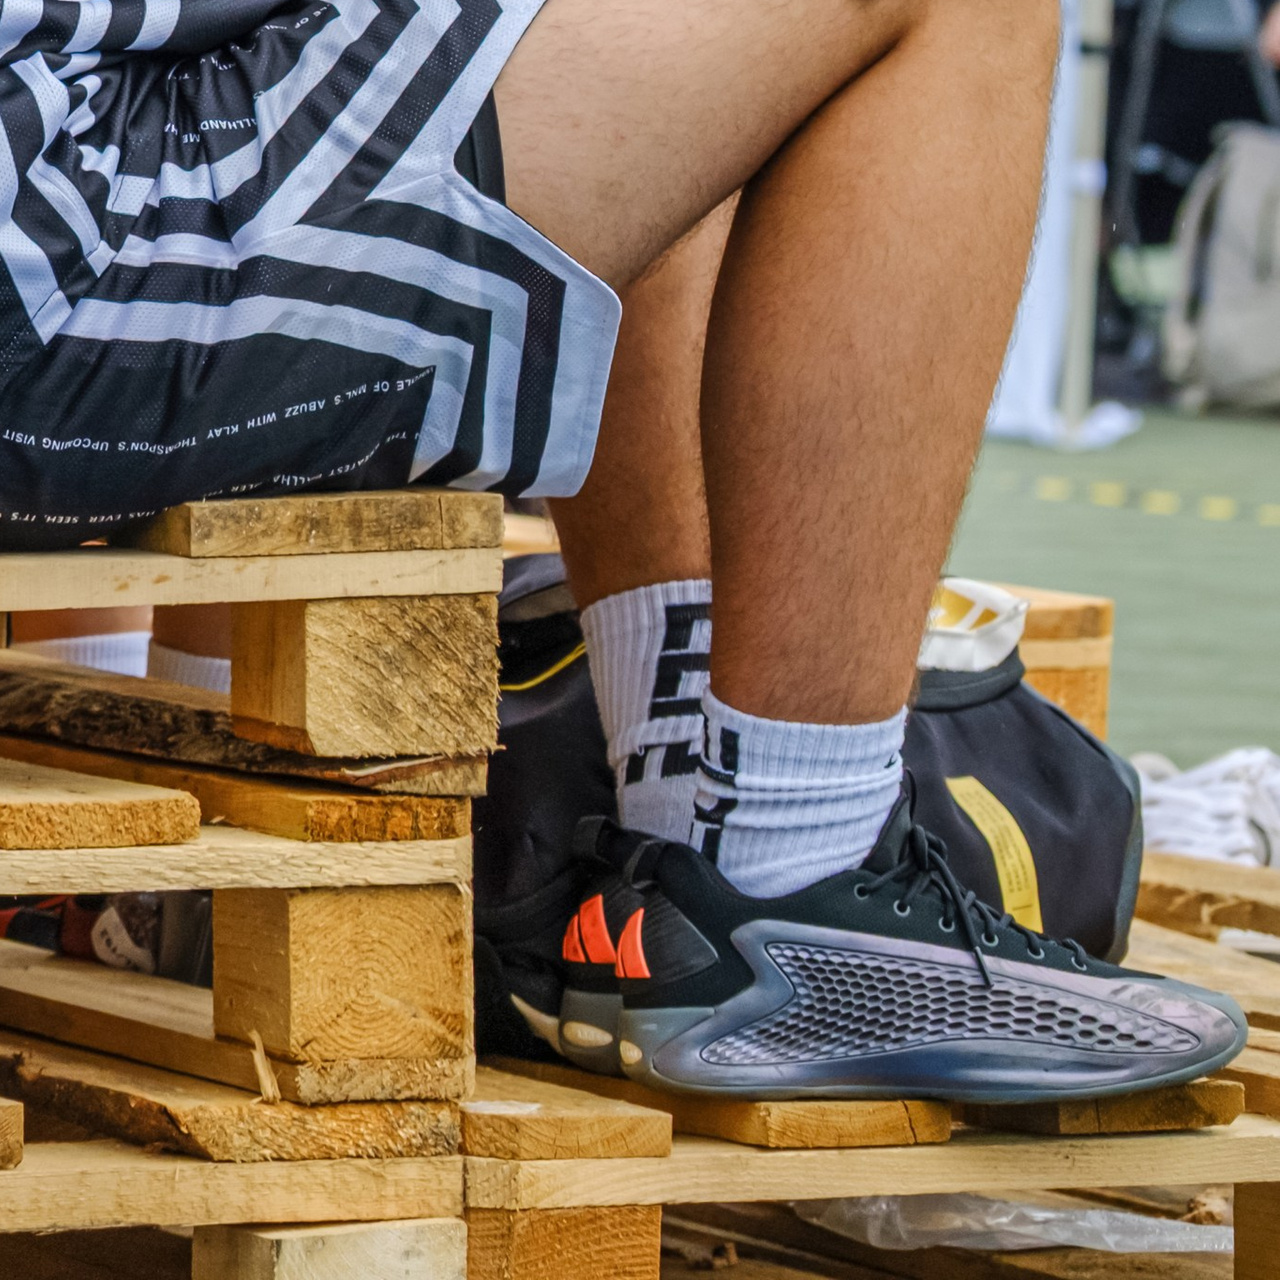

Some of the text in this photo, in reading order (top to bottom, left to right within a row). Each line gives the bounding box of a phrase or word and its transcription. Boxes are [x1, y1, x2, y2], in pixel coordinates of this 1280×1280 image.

[373, 381, 390, 392] OF
[284, 399, 326, 418] ABUZZ
[247, 411, 277, 429] WITH
[2, 429, 35, 446] VISIT
[206, 424, 239, 440] KLAY
[42, 437, 109, 451] UPCOMING
[11, 512, 37, 522] IT'S
